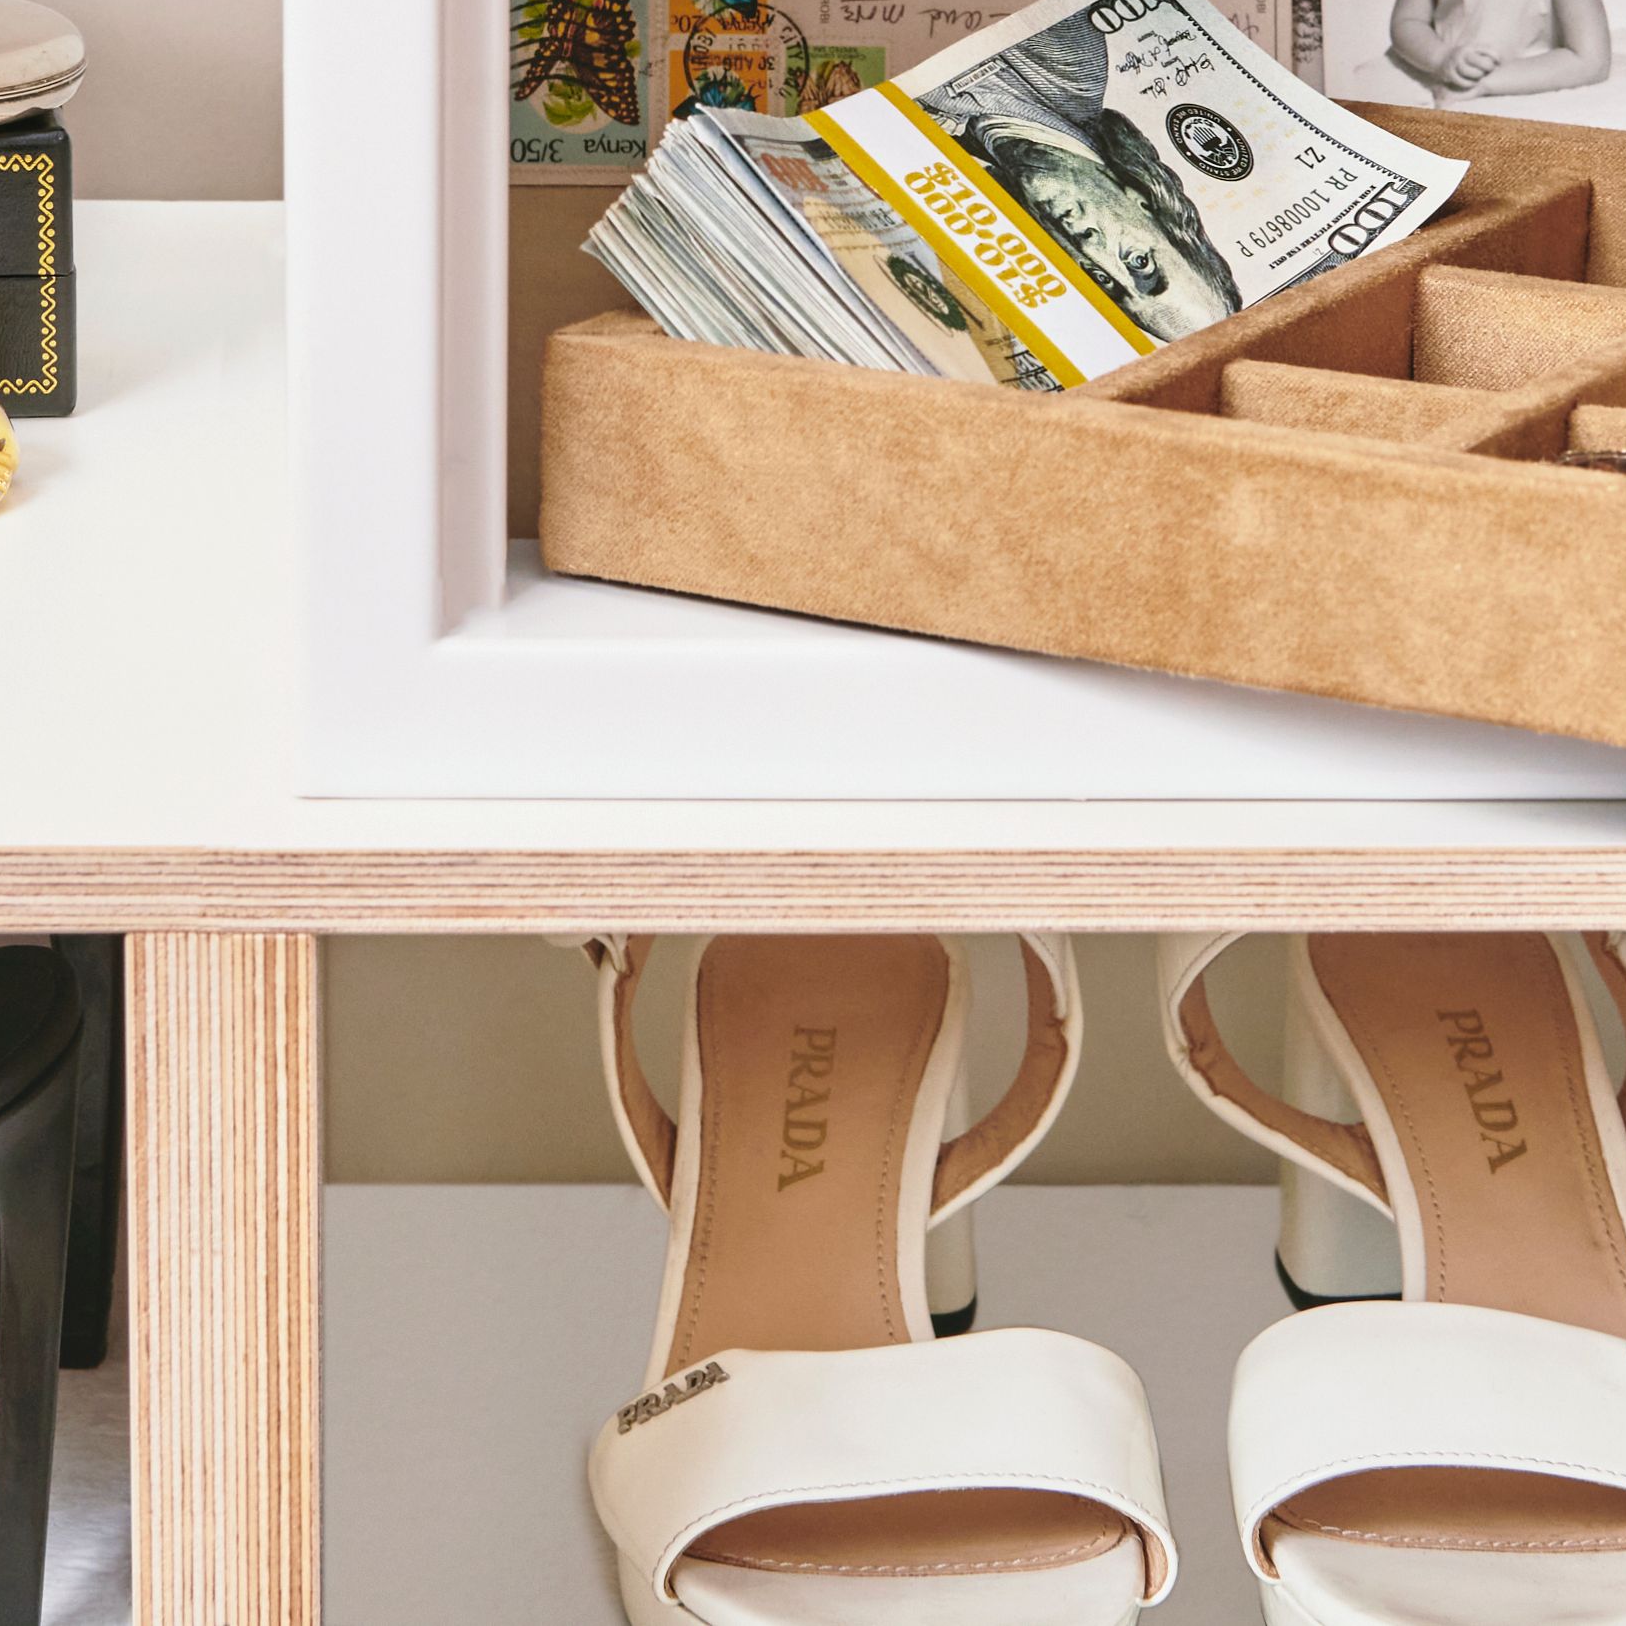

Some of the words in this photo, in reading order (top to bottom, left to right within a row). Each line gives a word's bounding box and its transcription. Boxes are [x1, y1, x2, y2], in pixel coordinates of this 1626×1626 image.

[510, 138, 564, 162] 3/50
[583, 134, 647, 158] Kenya
[1324, 167, 1358, 189] PR
[906, 173, 1048, 308] $10,000
[926, 161, 1066, 292] $10,000
[1235, 240, 1255, 257] P
[1249, 189, 1331, 248] 10008679
[1329, 181, 1409, 258] 100
[777, 1025, 837, 1192] PRADA
[1436, 1007, 1530, 1176] PRADA
[616, 1361, 730, 1434] PRADA
